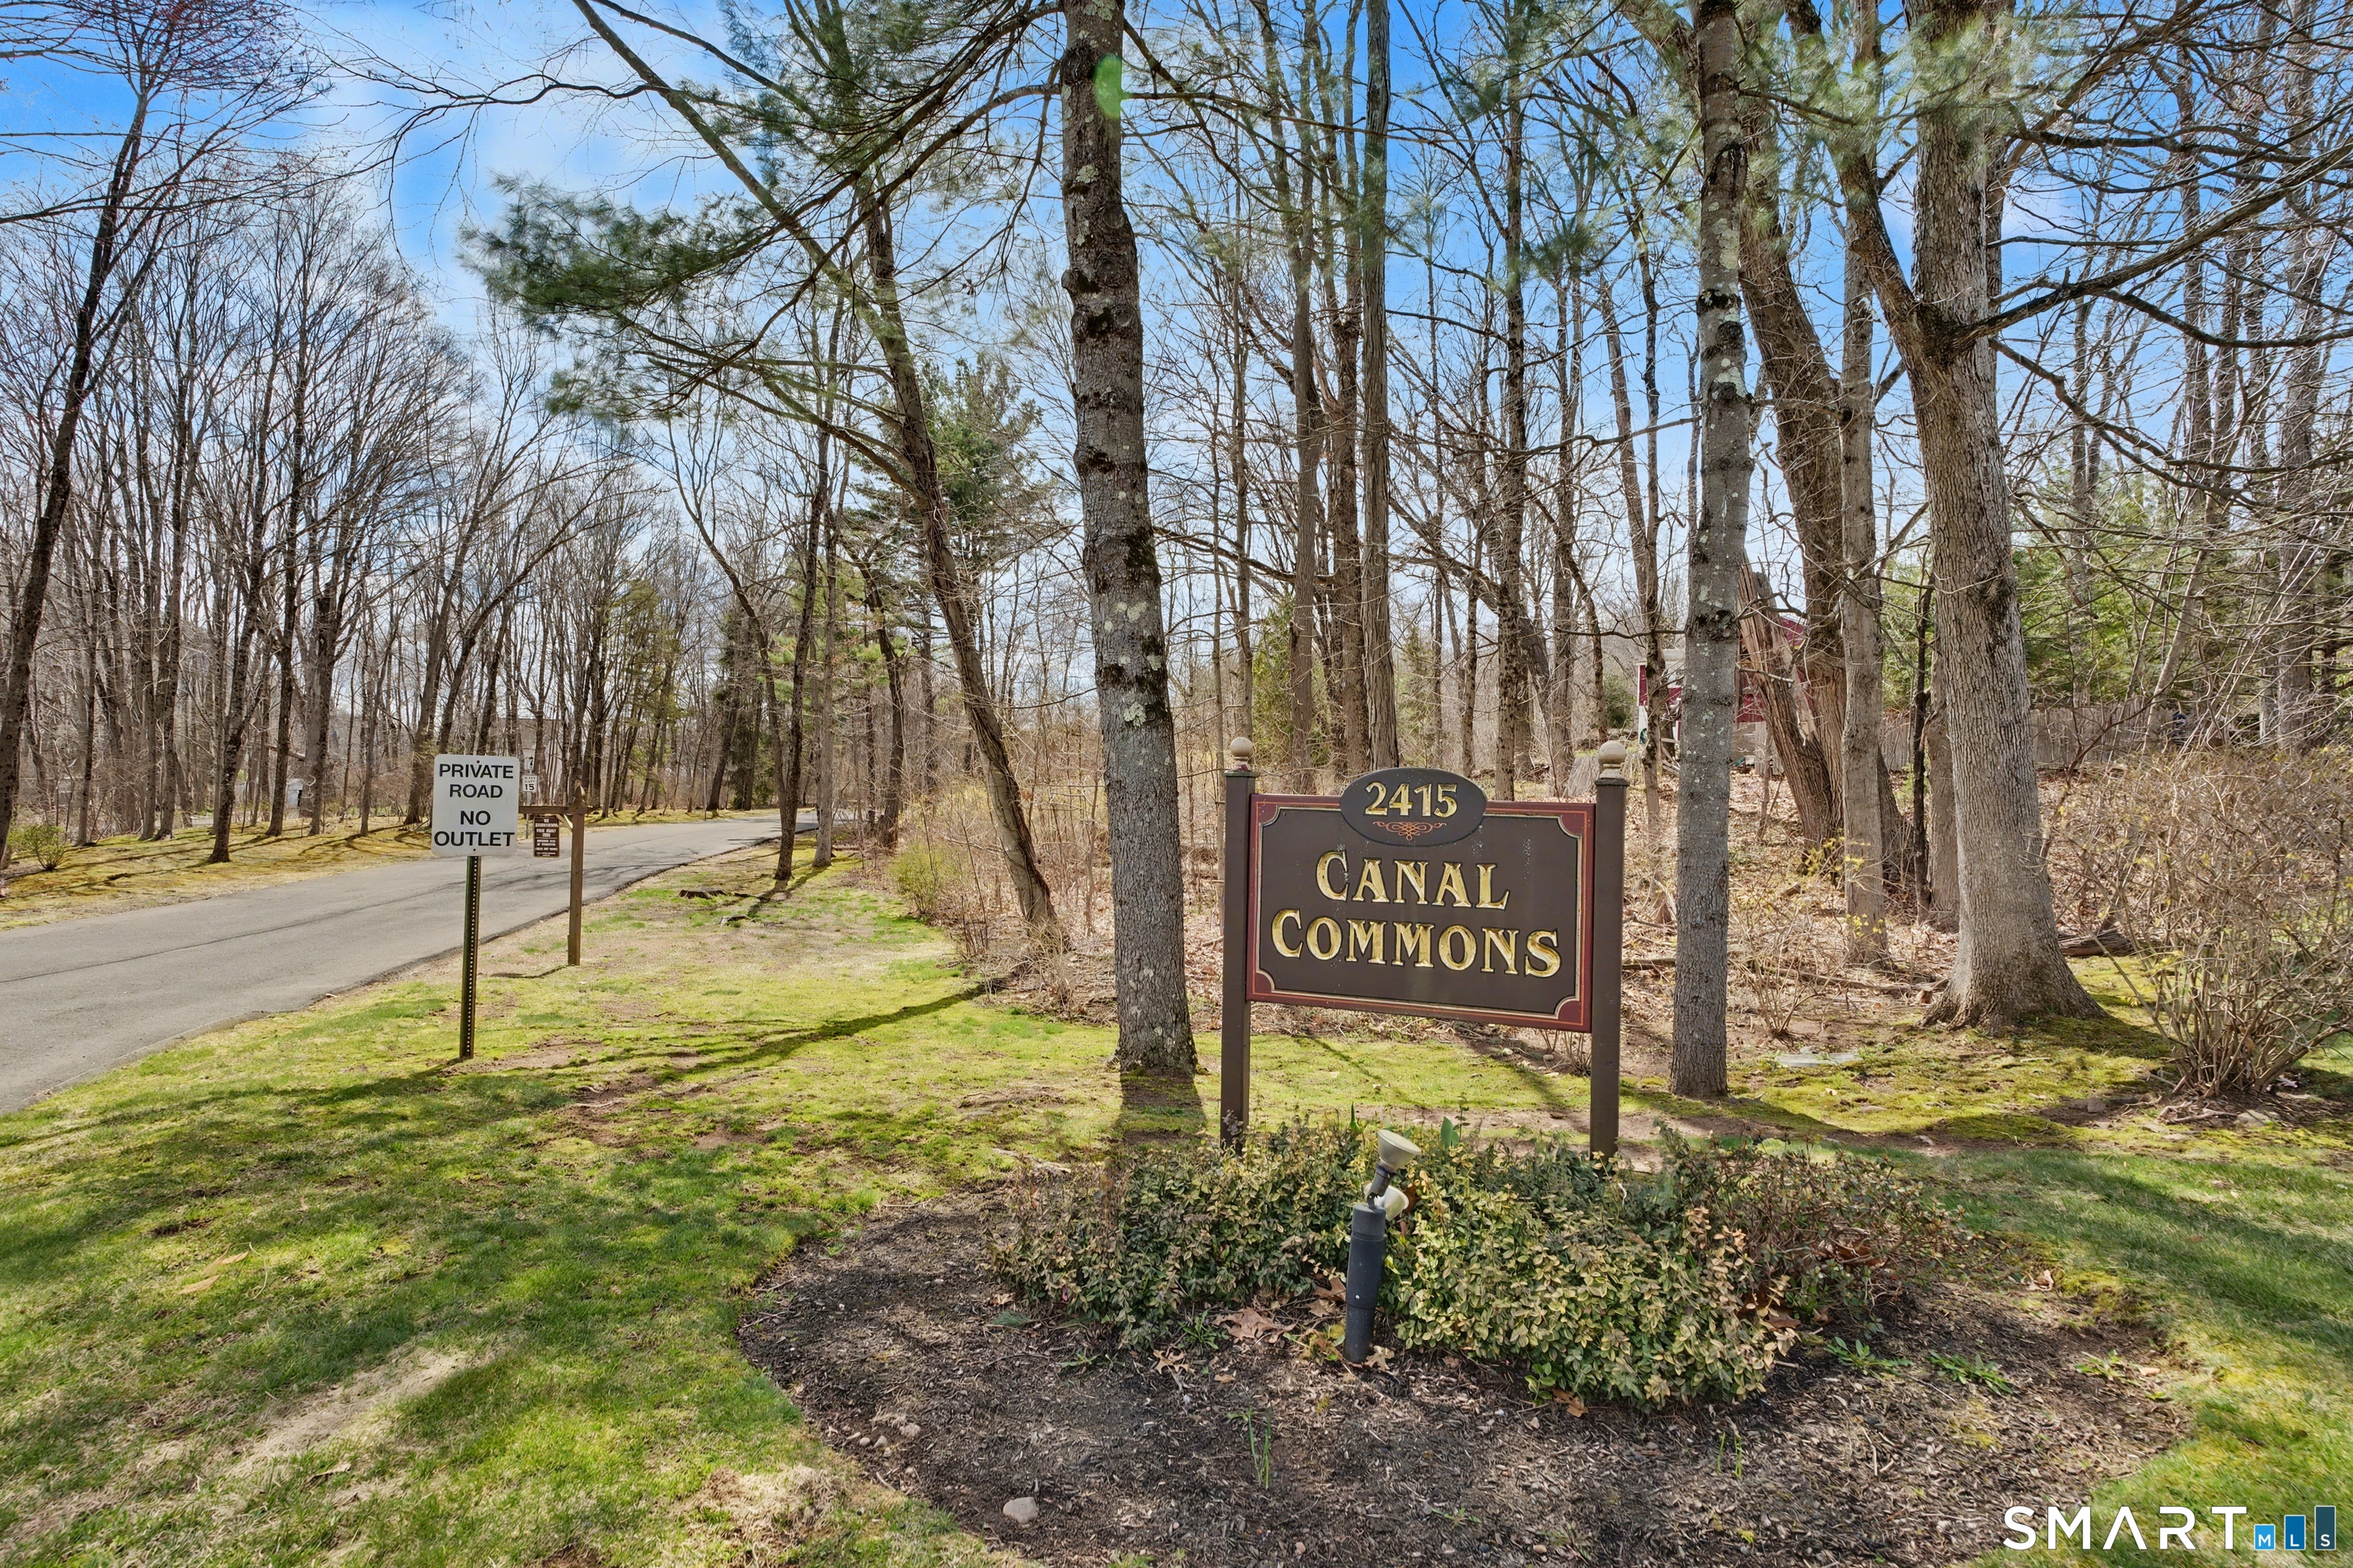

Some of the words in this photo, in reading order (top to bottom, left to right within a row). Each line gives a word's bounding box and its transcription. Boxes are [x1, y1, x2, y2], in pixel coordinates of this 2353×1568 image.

[439, 763, 514, 779] PRIVATE
[449, 784, 503, 798] ROAD
[1365, 781, 1458, 817] 2415
[460, 810, 491, 826] NO
[434, 830, 515, 846] OUTLET
[1315, 849, 1510, 911] CANAL
[1271, 908, 1563, 977] COMMONS
